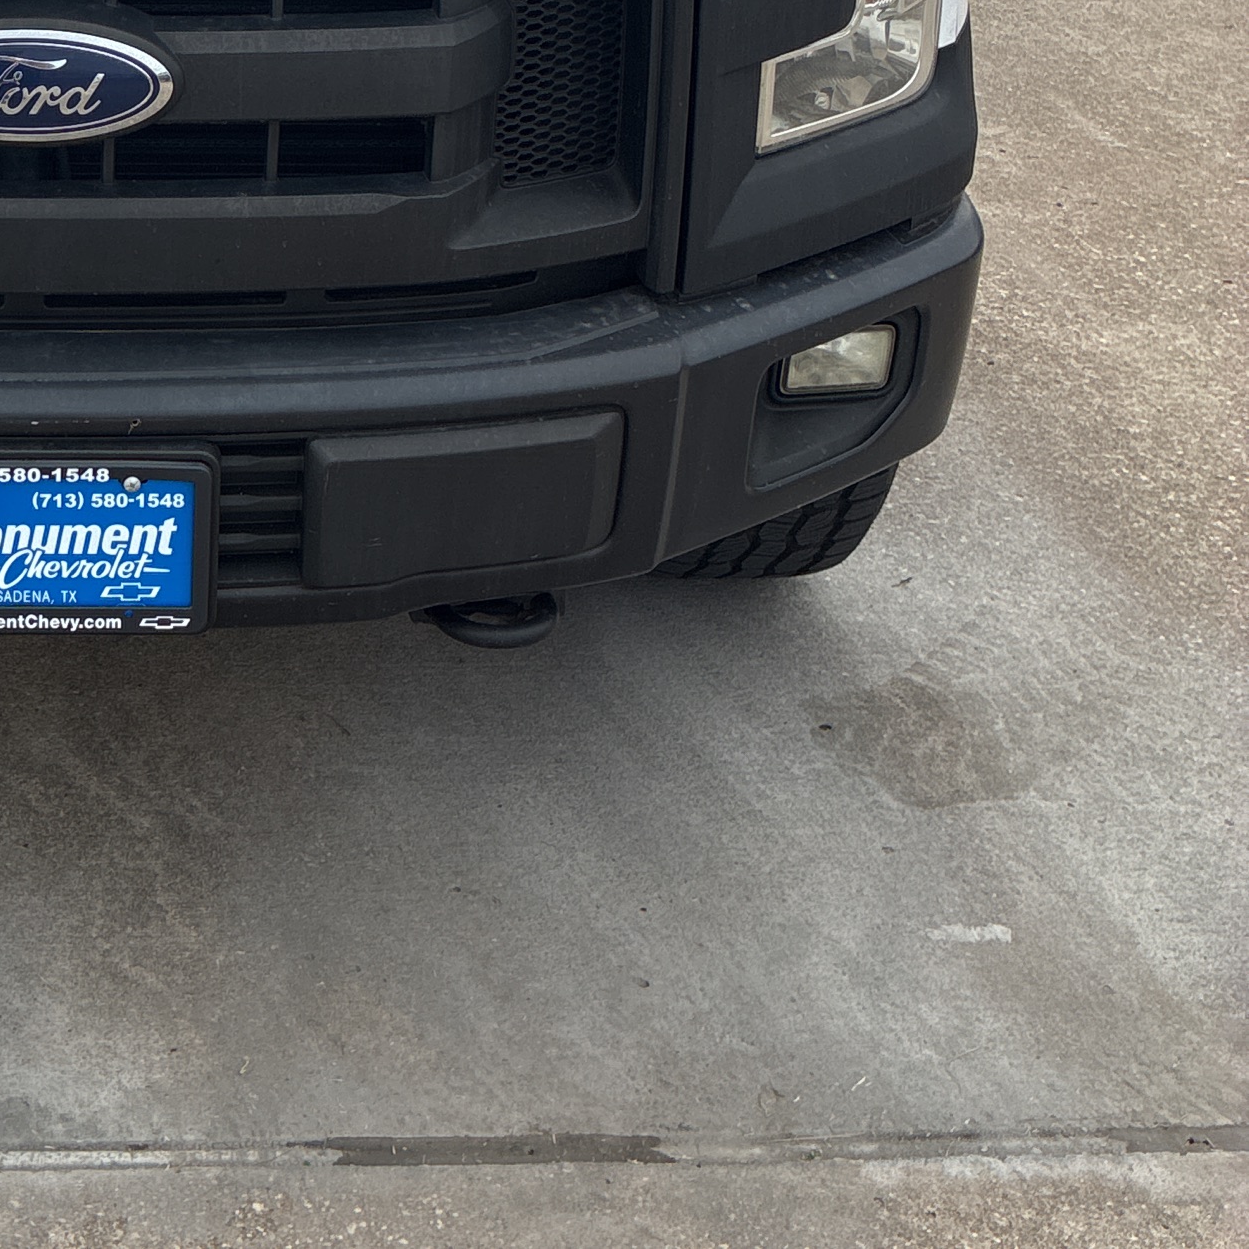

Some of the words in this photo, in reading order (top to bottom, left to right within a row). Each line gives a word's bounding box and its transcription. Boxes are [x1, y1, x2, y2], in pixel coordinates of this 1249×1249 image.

[32, 492, 84, 510] (713)
[91, 493, 185, 508] 580-1548
[60, 590, 77, 603] TX
